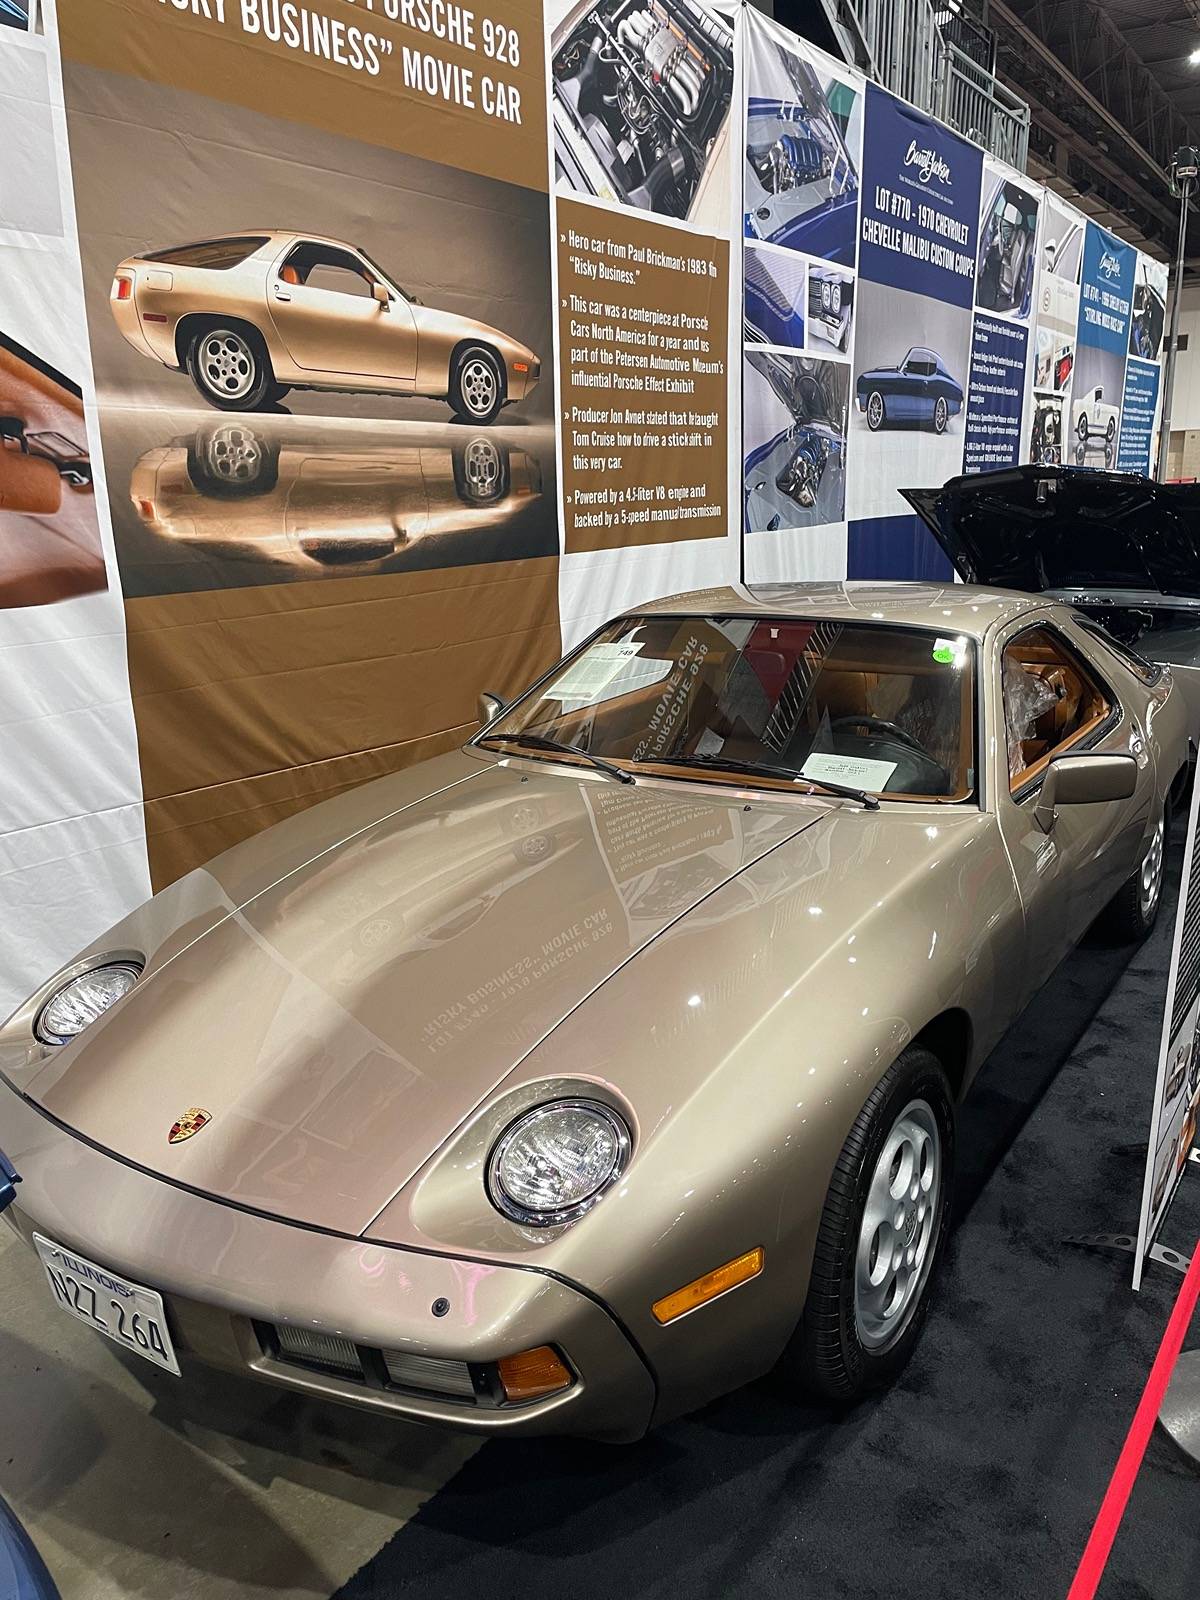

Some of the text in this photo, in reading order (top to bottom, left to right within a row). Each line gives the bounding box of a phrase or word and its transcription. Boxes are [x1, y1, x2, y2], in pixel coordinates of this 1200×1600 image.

[366, 0, 520, 67] ORSCHE 928
[402, 46, 475, 109] MOVIE
[481, 76, 522, 125] CAR
[876, 186, 890, 213] LOT
[891, 194, 911, 221] #770
[918, 204, 934, 230] 1970
[935, 210, 969, 245] CHEVROLET
[568, 230, 589, 250] Hero
[591, 237, 605, 253] car
[607, 239, 626, 259] from
[628, 244, 645, 262] Paul
[647, 249, 685, 272] Brickman's
[687, 258, 707, 274] 1983
[862, 217, 975, 278] CHEVELLE MALIBU CUSTOM COUPE
[570, 256, 640, 285] “Risky Business.”
[570, 295, 587, 313] This
[589, 300, 603, 316] car
[605, 303, 620, 319] was
[621, 307, 626, 319] a
[628, 306, 671, 327] centerpiece
[672, 313, 679, 328] at
[570, 320, 590, 337] Cars
[592, 322, 613, 340] North
[615, 326, 646, 345] America
[648, 331, 659, 347] for
[660, 337, 664, 348] a
[665, 337, 681, 351] year
[683, 337, 699, 351] and
[571, 348, 588, 364] part
[591, 348, 599, 363] of
[600, 350, 613, 365] the
[615, 351, 648, 368] Petersen
[650, 354, 690, 372] Automotive
[571, 370, 694, 393] influential Porsche Effect Exhibit
[572, 407, 609, 424] Producer
[610, 409, 623, 424] Jon
[646, 411, 667, 425] stated
[669, 411, 688, 425] that
[695, 412, 718, 428] taught
[572, 430, 589, 447] Tom
[591, 431, 615, 447] Cruise
[617, 432, 631, 447] how
[633, 433, 642, 446] to
[643, 432, 659, 447] drive
[661, 437, 666, 446] a
[668, 432, 688, 447] stick
[704, 432, 712, 446] in
[573, 455, 622, 472] this very car.
[575, 489, 608, 504] Powered
[609, 490, 617, 505] by
[619, 492, 624, 502] a
[656, 486, 664, 500] V8
[690, 484, 706, 497] and
[575, 512, 603, 528] backed
[605, 511, 612, 528] by
[614, 514, 619, 524] a
[621, 508, 649, 525] 5-speed
[62, 1253, 134, 1298] ILLINOIS
[110, 1299, 168, 1361] 264
